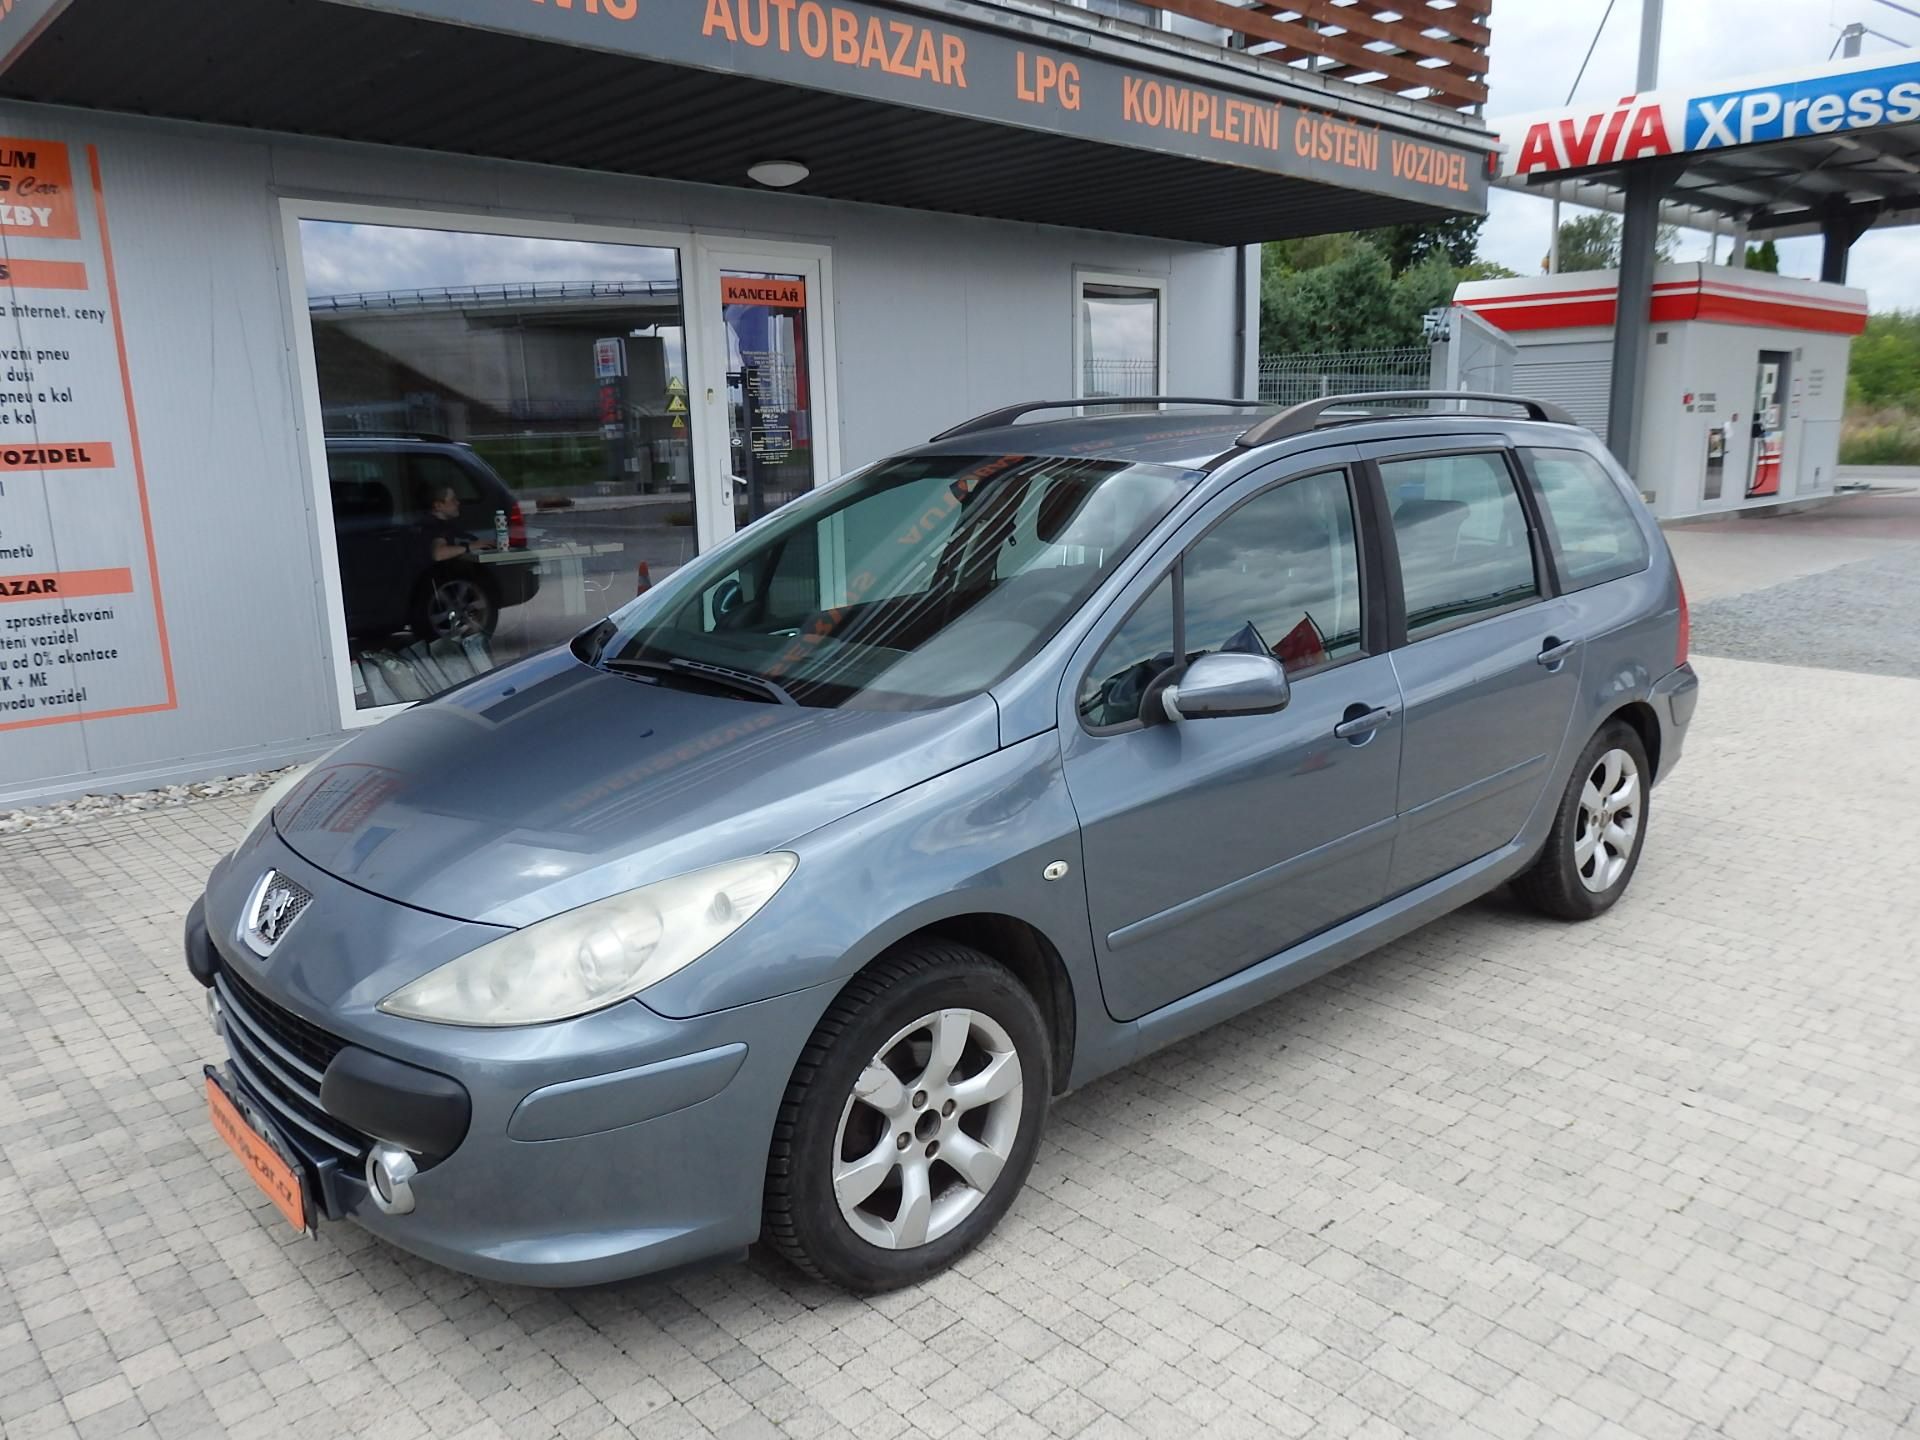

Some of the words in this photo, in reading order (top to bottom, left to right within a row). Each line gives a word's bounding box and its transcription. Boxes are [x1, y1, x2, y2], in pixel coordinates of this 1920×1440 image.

[702, 0, 967, 88] AUTOBAZAR
[1016, 51, 1081, 110] LPG
[1123, 75, 1283, 151] KOMPLETNÍ
[1294, 105, 1381, 172] ČIŠTĚNÍ
[1391, 140, 1470, 192] VOZIDEL
[1694, 82, 1920, 151] XPress
[728, 286, 799, 302] KANCELÁŘ
[74, 309, 106, 324] ceny
[37, 350, 70, 364] pneu
[38, 392, 46, 403] a
[50, 386, 73, 403] kol
[14, 408, 37, 425] kol
[0, 448, 91, 465] OZIDEL
[31, 628, 79, 646] vozidel
[12, 653, 29, 669] od
[33, 650, 54, 667] 0%
[58, 649, 119, 664] akontace
[29, 671, 48, 688] ME
[40, 686, 87, 705] vozidel
